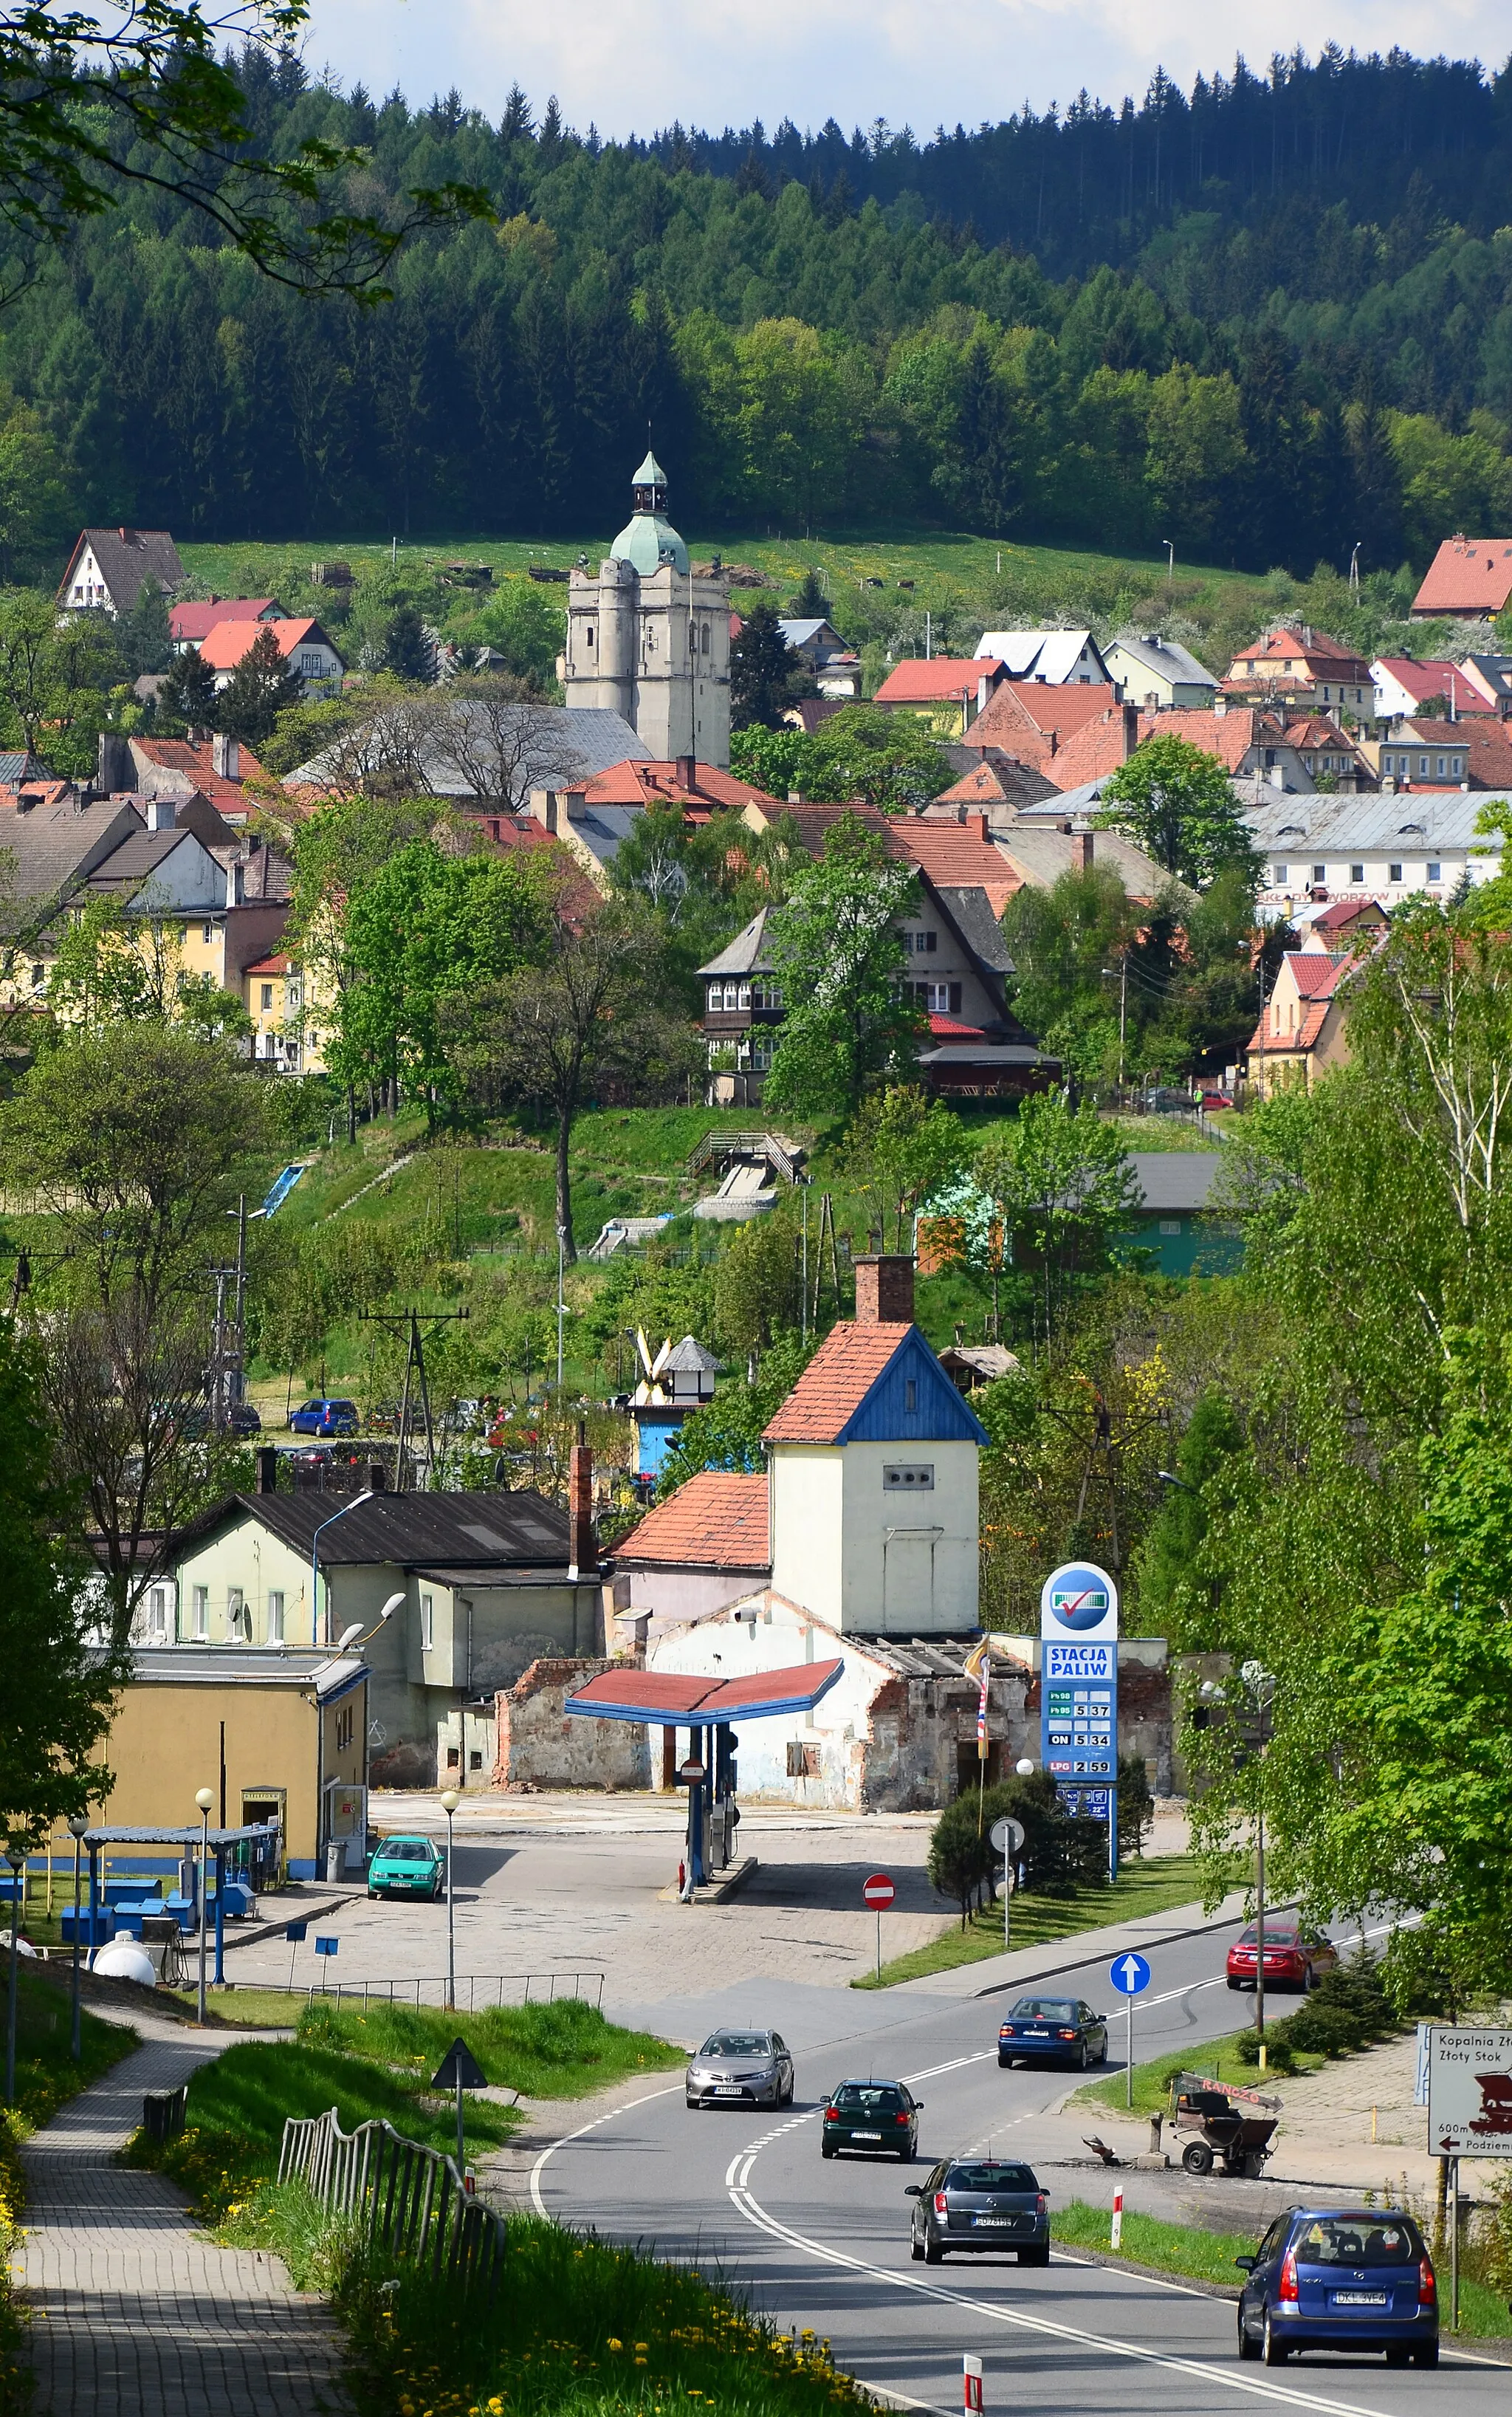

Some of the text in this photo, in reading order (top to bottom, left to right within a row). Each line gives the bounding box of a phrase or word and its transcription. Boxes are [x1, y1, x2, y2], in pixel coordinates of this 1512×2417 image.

[1051, 1648, 1107, 1661] STACJA
[1051, 1663, 1107, 1676] PALIW
[1051, 1735, 1068, 1744] ON
[1050, 1762, 1070, 1771] LPG
[1439, 2034, 1512, 2048] Kopalnia Zł
[1440, 2050, 1502, 2063] Złoty Stok
[1202, 2079, 1260, 2104] RANCZO
[1466, 2140, 1512, 2150] Podziem
[1339, 2292, 1358, 2303] DKL
